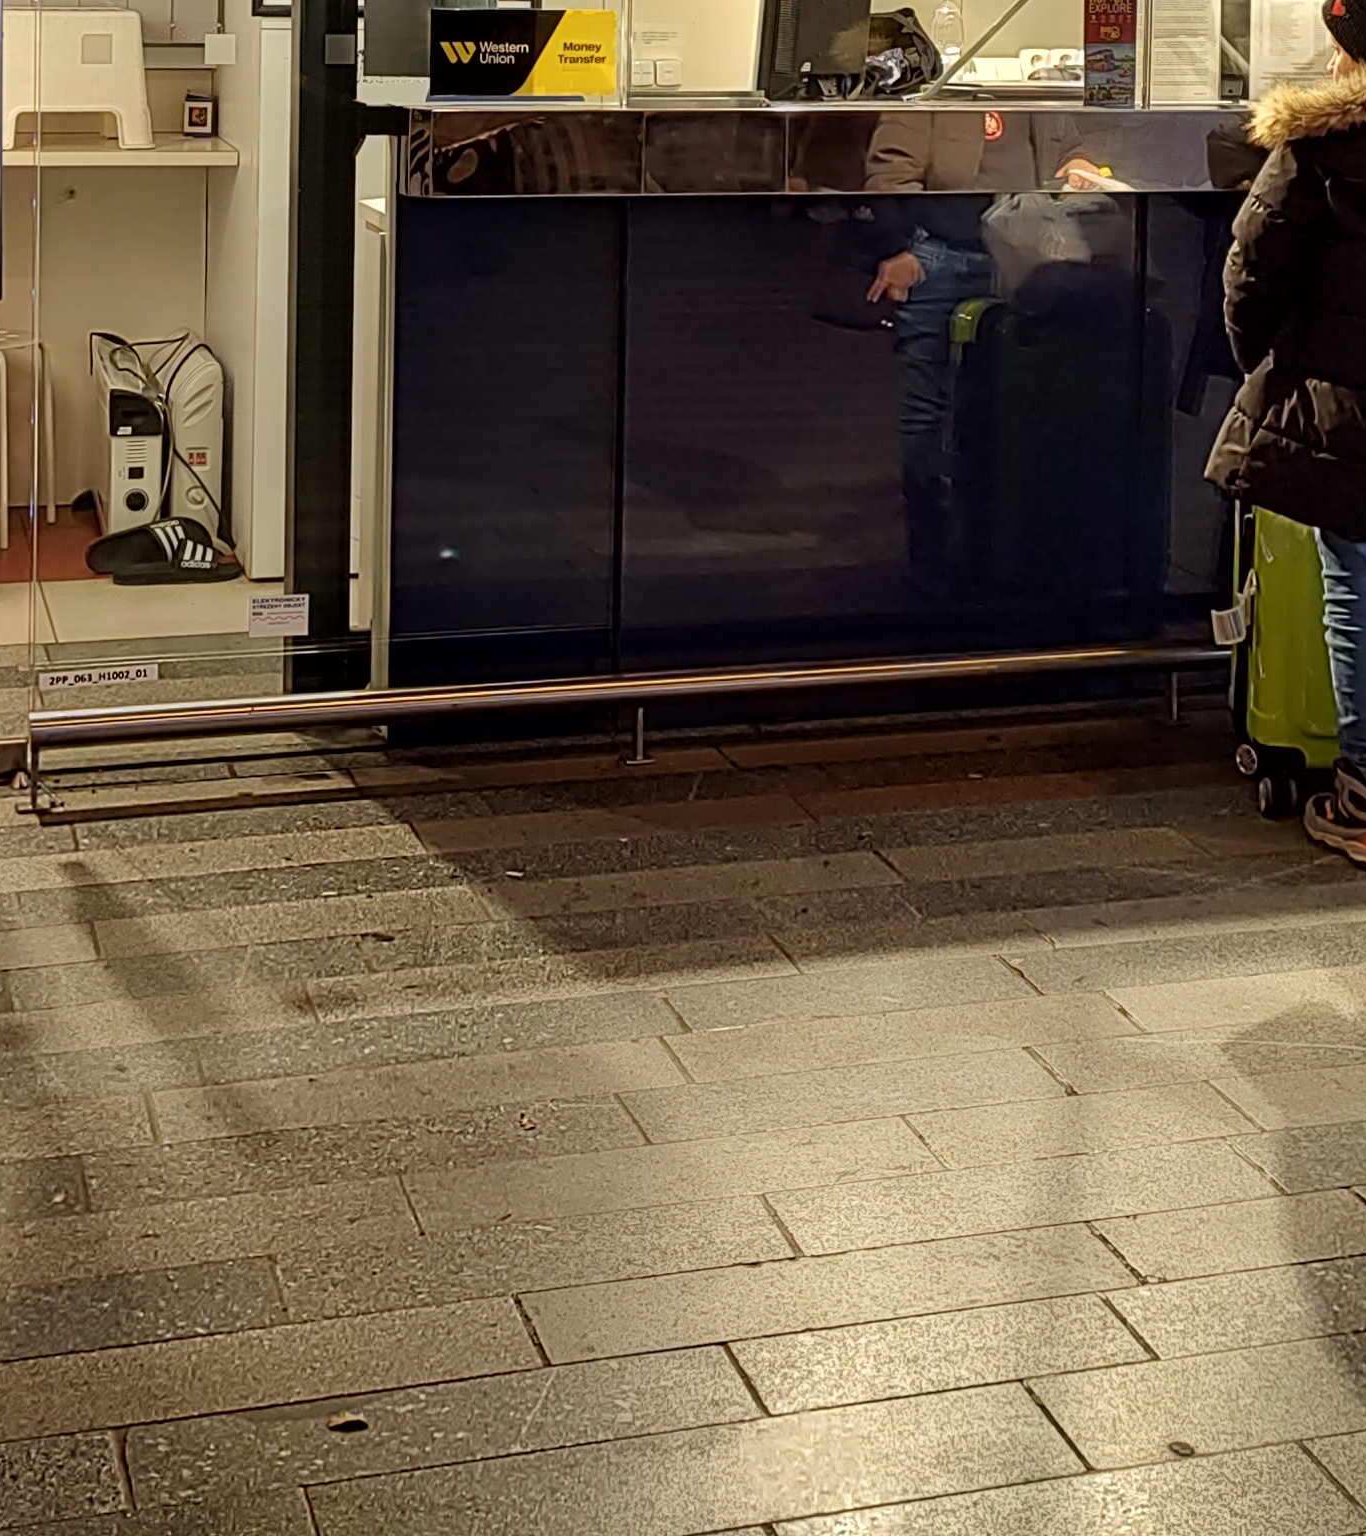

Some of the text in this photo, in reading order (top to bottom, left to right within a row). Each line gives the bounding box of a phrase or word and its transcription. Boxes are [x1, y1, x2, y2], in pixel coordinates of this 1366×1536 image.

[1088, 3, 1133, 13] EXPLORE
[479, 41, 530, 54] Western
[563, 41, 603, 57] Money
[479, 52, 516, 65] Union
[557, 52, 608, 66] Transfer
[181, 560, 211, 569] adidas
